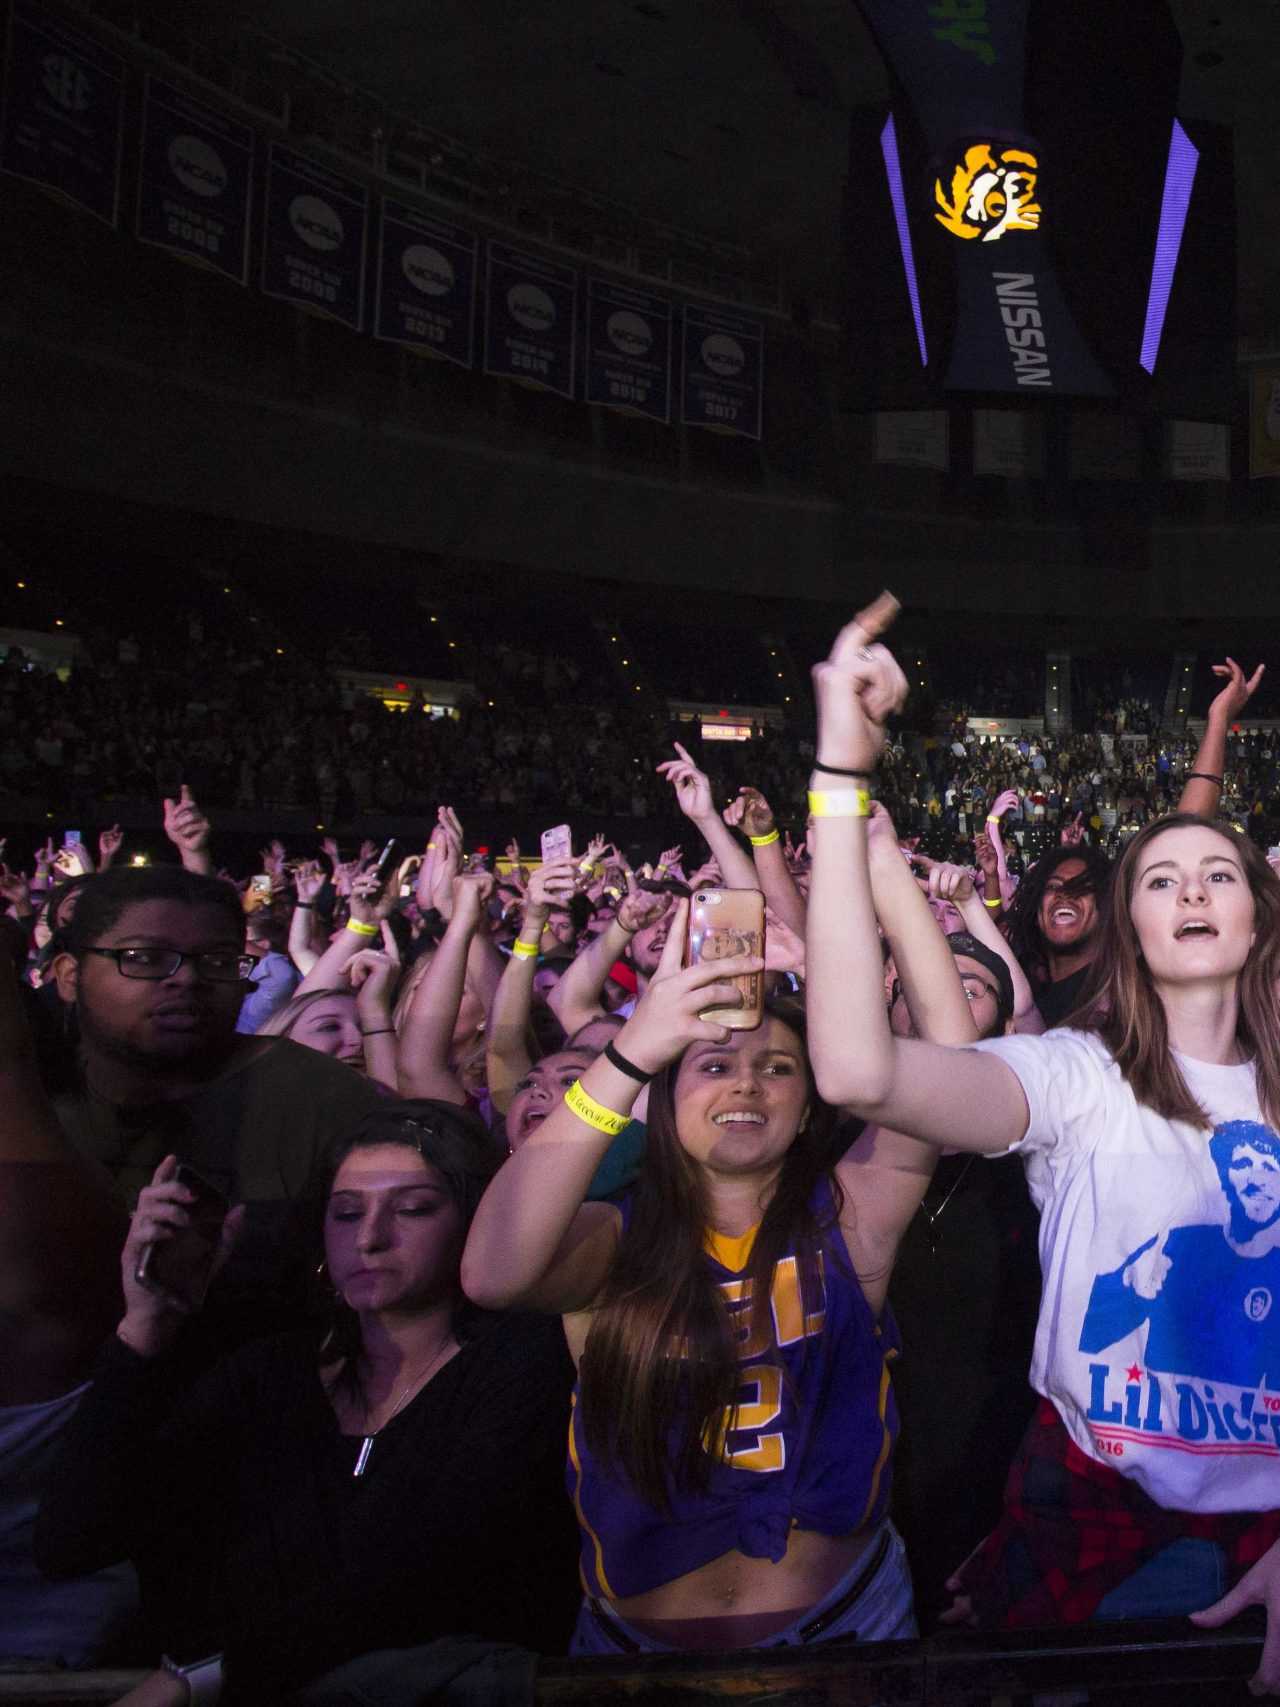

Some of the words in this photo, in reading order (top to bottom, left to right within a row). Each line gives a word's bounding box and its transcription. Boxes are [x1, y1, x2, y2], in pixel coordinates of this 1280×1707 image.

[991, 271, 1053, 387] NISSAN
[700, 1364, 786, 1473] 2
[1087, 1362, 1163, 1432] Lil
[1096, 1438, 1124, 1457] 016
